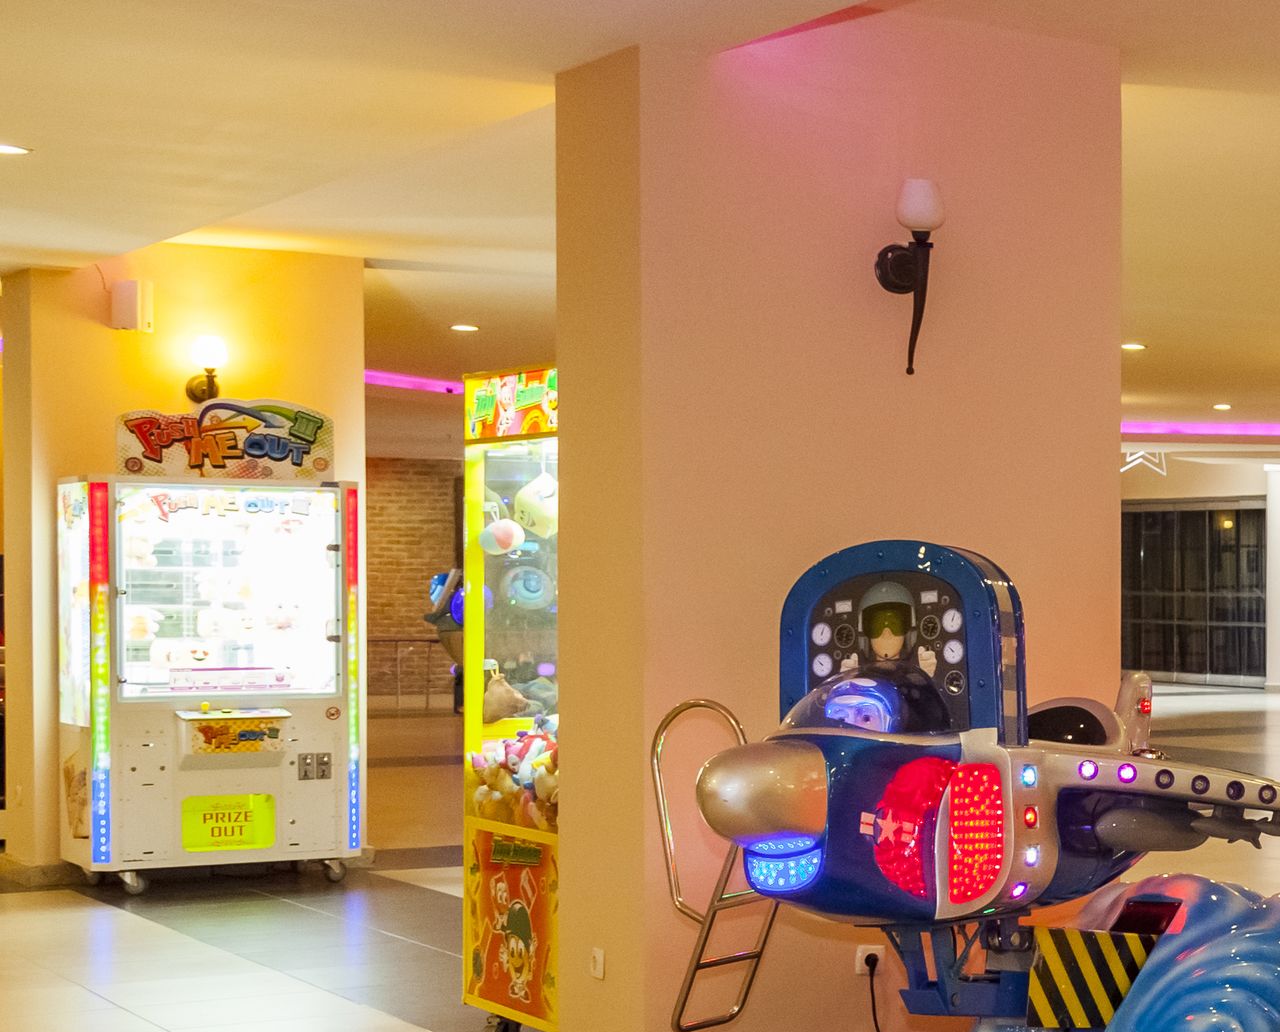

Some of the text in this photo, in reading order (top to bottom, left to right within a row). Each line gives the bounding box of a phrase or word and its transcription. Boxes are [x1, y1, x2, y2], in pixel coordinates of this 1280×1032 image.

[189, 431, 244, 468] ME
[244, 432, 311, 467] OUT
[203, 811, 254, 824] PRIZE
[210, 825, 246, 838] OUT
